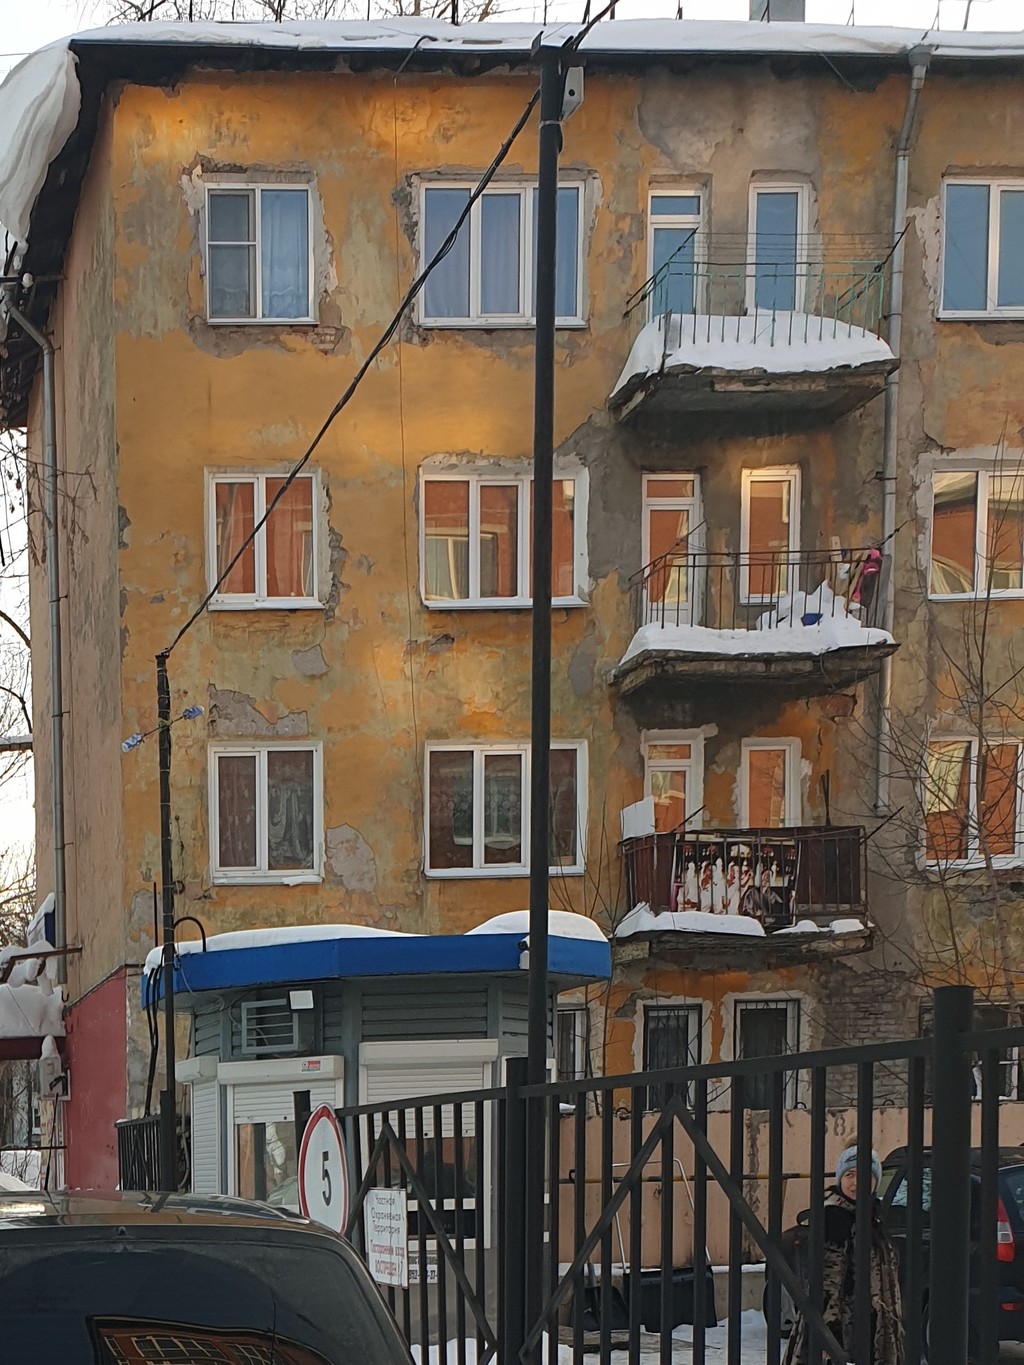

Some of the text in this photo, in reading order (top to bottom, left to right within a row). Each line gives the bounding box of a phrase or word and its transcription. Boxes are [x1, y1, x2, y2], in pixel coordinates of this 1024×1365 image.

[322, 1151, 331, 1206] 5
[376, 1193, 395, 1206] Частная
[372, 1220, 400, 1236] Территория
